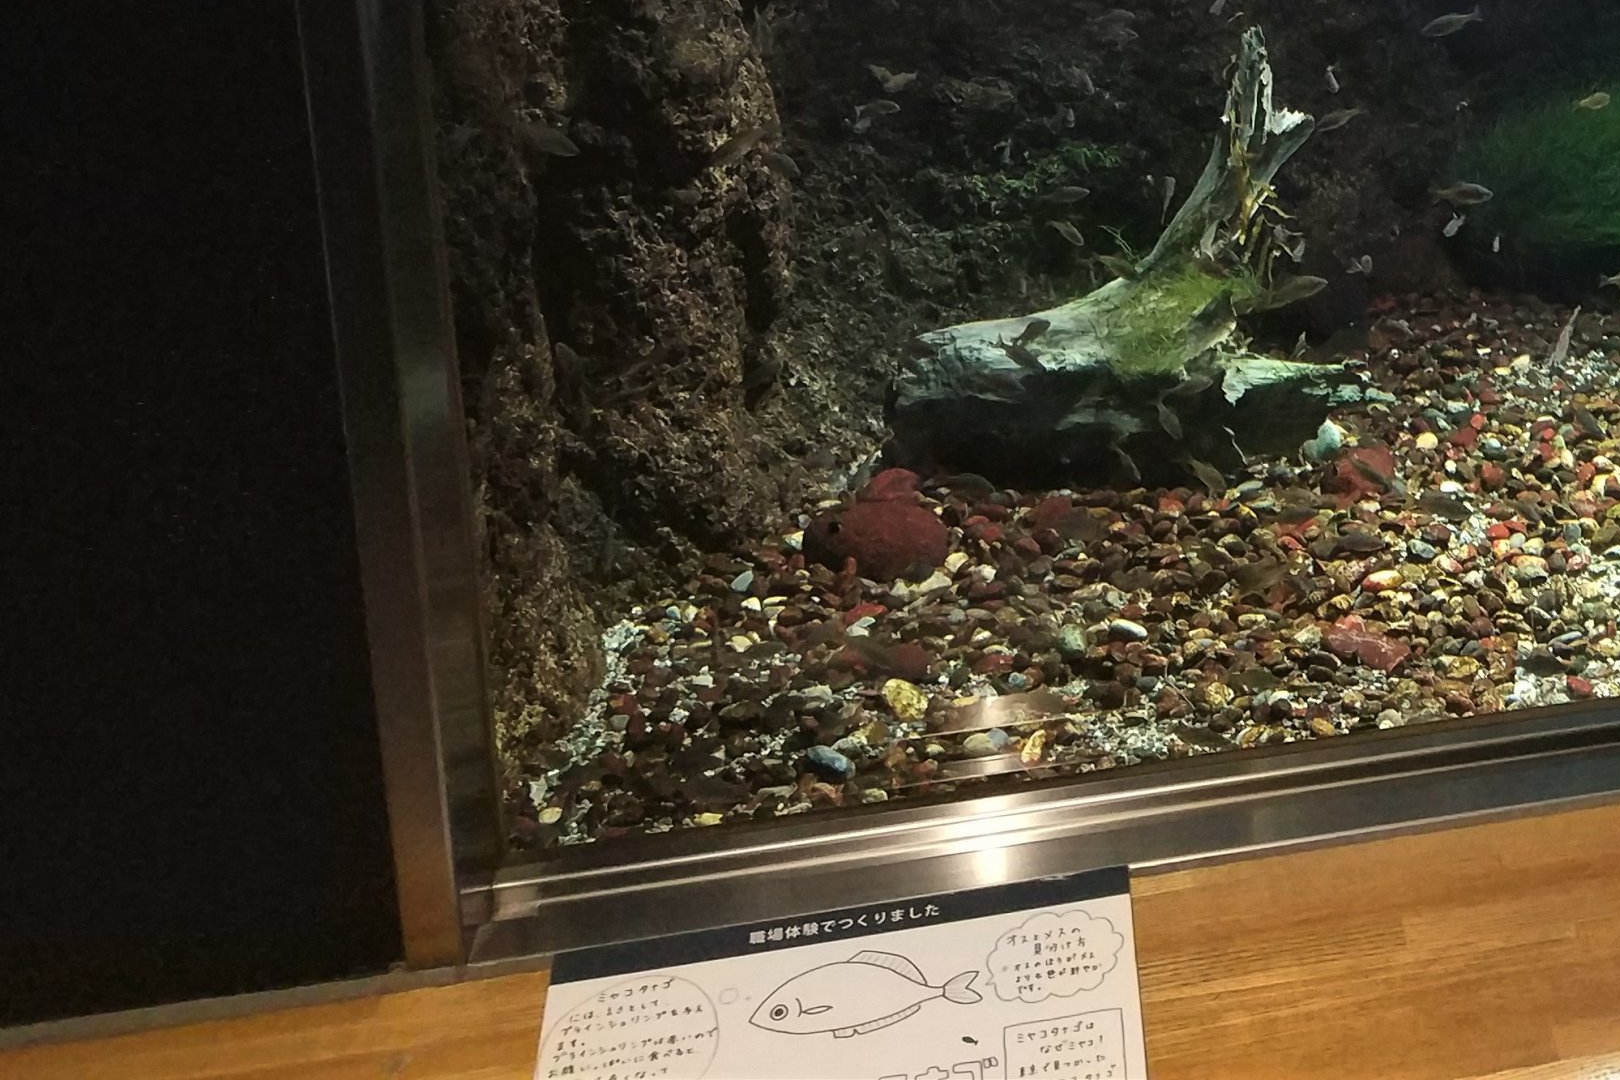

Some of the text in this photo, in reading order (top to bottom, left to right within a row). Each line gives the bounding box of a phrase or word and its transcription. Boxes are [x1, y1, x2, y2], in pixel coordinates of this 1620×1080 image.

[749, 904, 940, 944] 職場体験でつくりました
